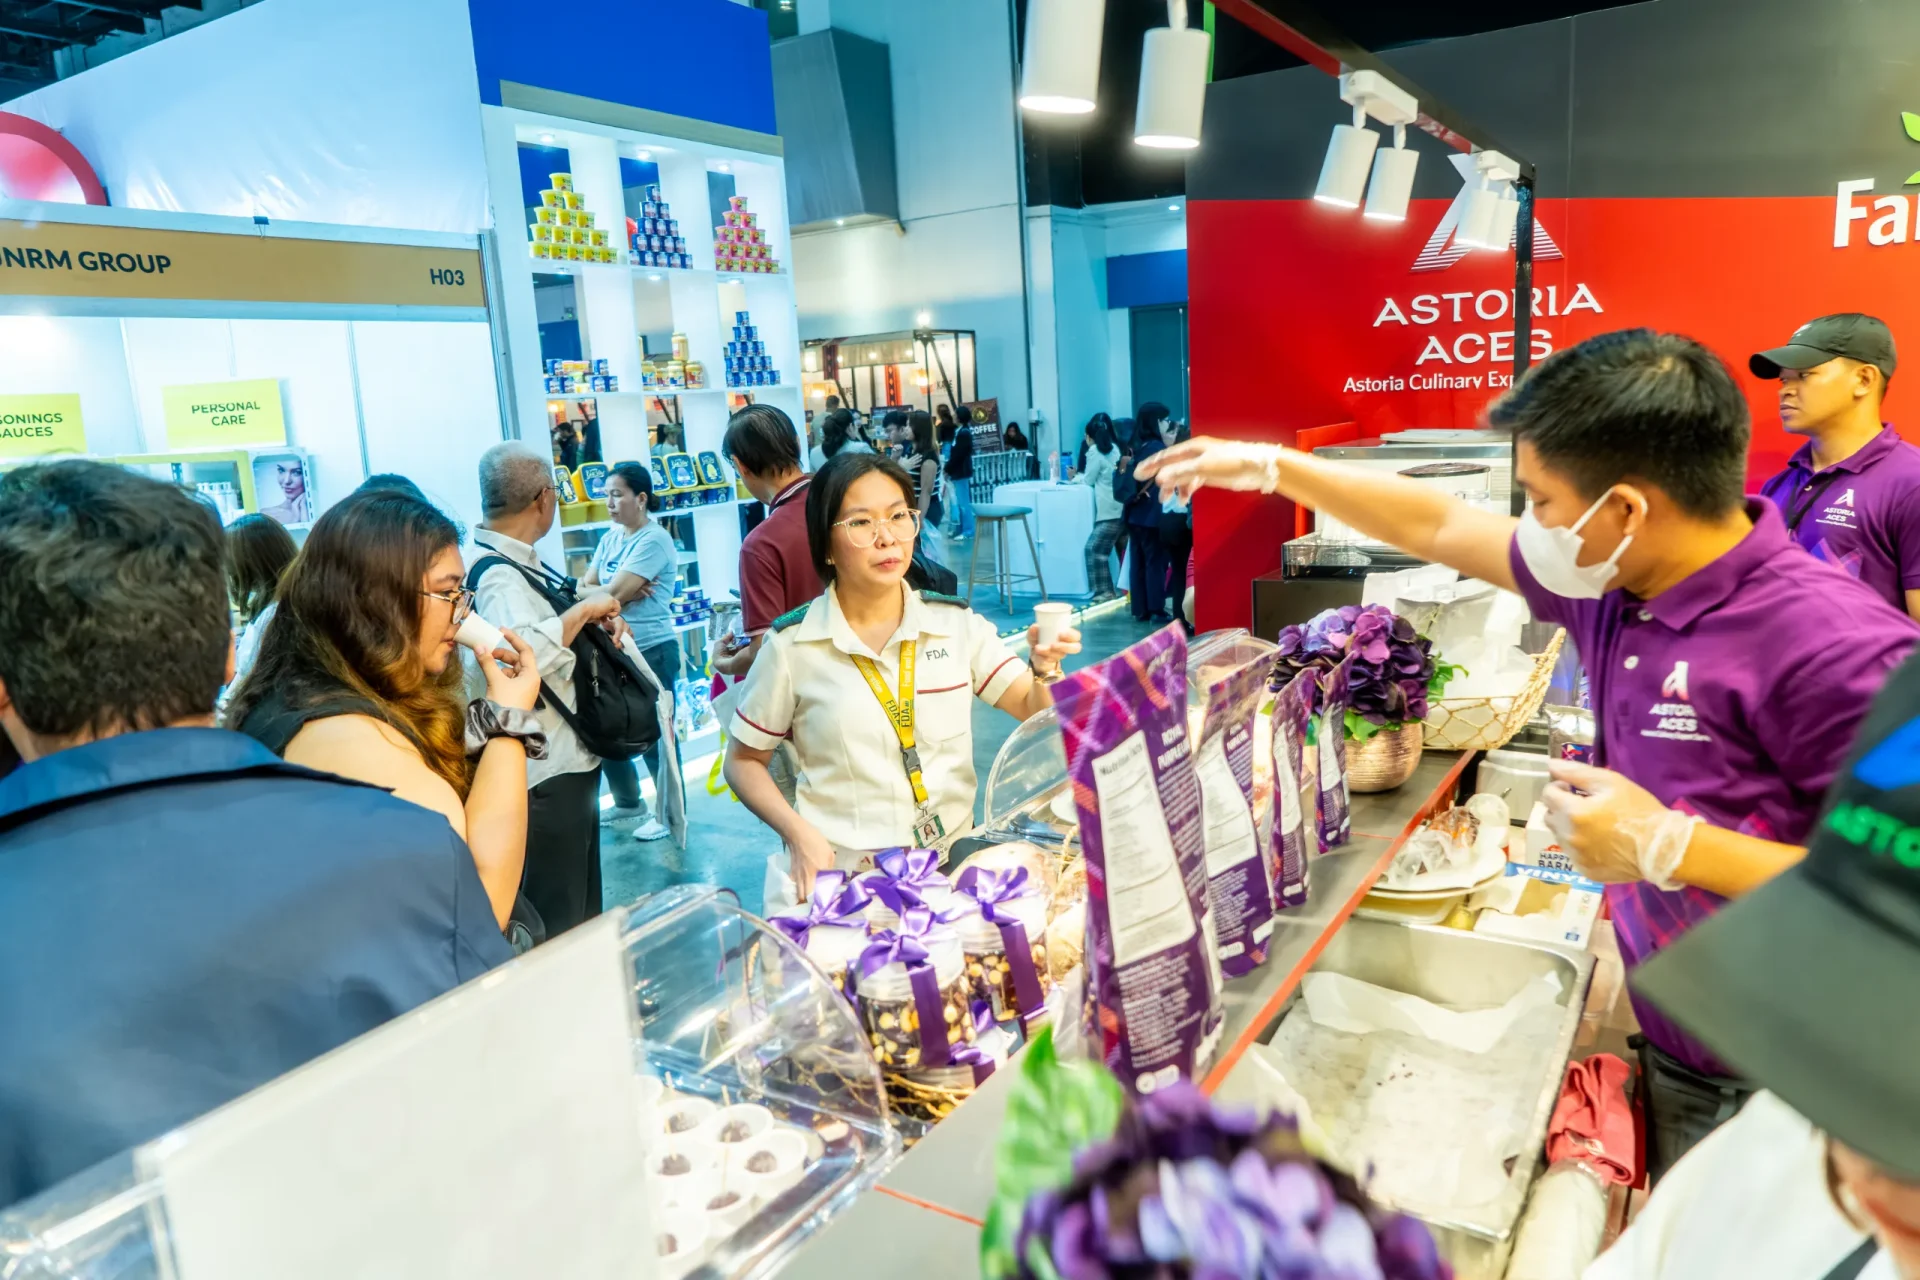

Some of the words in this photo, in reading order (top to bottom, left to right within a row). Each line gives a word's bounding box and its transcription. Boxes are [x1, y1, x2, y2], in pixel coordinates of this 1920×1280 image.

[0, 246, 73, 270] NRM
[78, 251, 171, 274] GROUP
[430, 268, 465, 286] H03
[1415, 329, 1553, 366] ACES
[1343, 376, 1404, 393] Astoria
[1409, 373, 1483, 391] Culinary
[191, 401, 261, 414] PERSONAL
[211, 414, 246, 426] CARE
[0, 426, 53, 438] AUCES
[1825, 514, 1847, 522] ACES
[925, 648, 949, 661] FDA
[886, 699, 901, 719] FDA
[1648, 703, 1697, 717] ASTOR
[900, 708, 911, 728] FDA
[1657, 717, 1698, 732] ACES
[1540, 852, 1570, 862] HAPPY
[1538, 859, 1573, 872] BARN
[1516, 866, 1593, 886] VINYL
